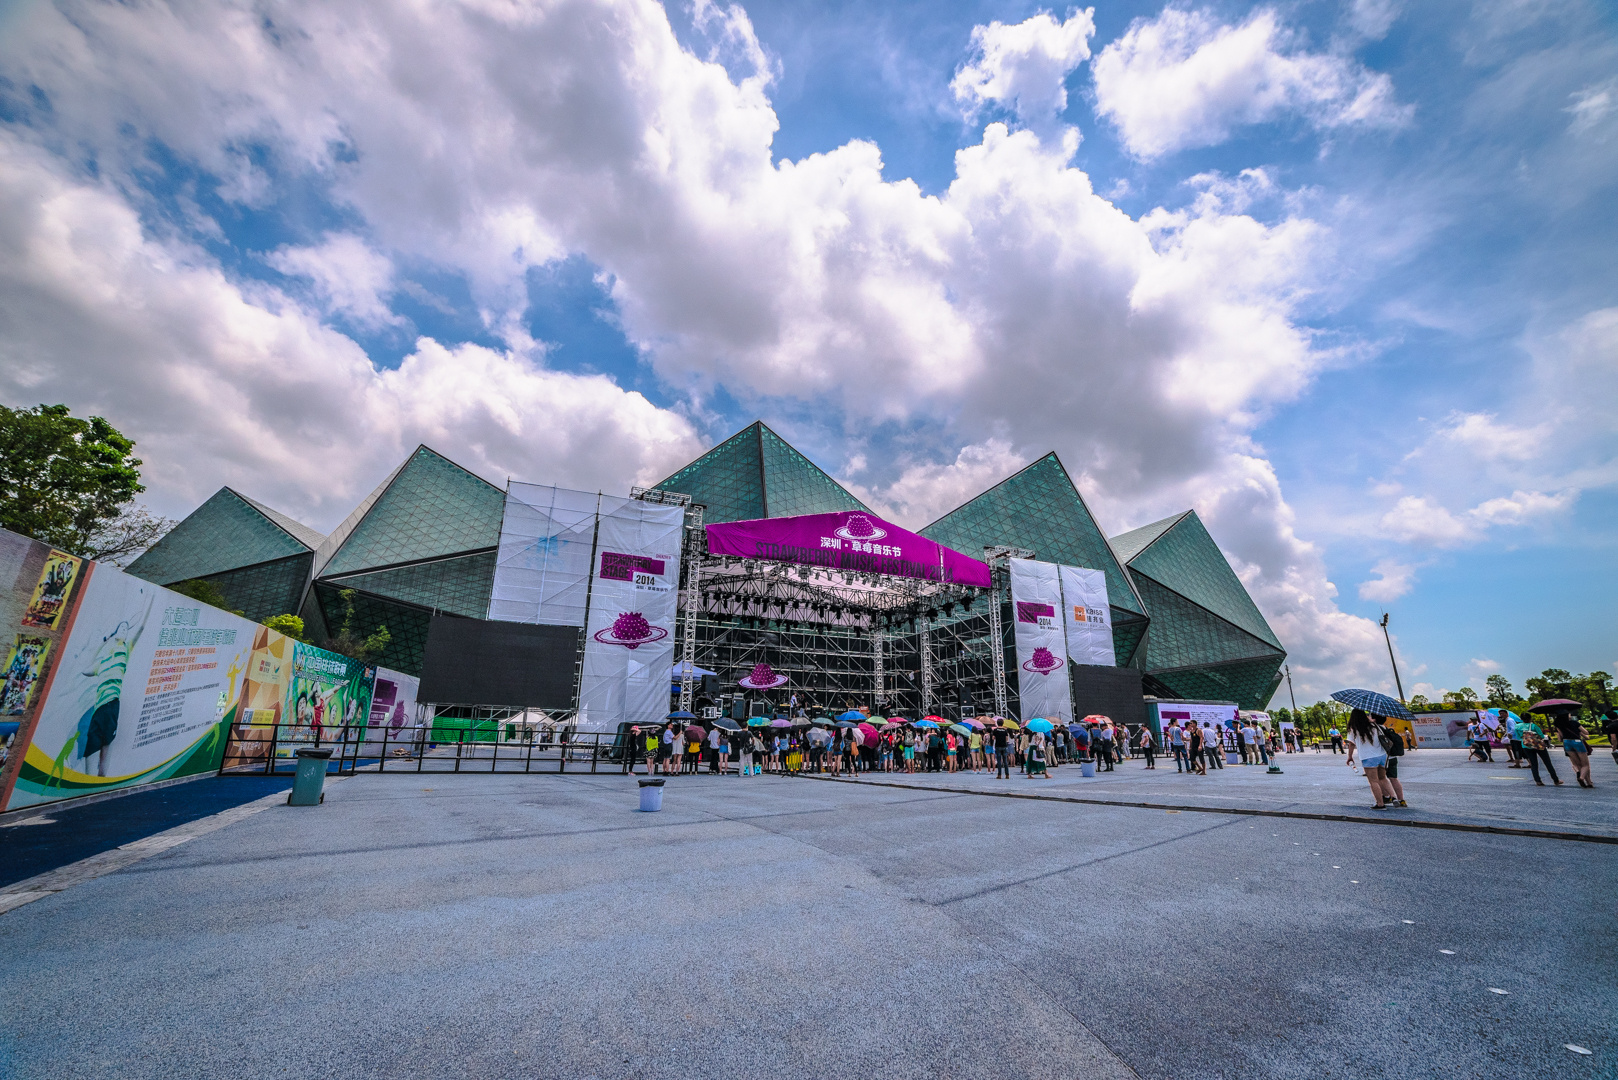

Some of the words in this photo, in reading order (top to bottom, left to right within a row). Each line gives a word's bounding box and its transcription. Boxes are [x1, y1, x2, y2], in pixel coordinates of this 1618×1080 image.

[755, 541, 837, 567] STRAWBERRY
[840, 552, 878, 571] MUSIC
[881, 558, 927, 578] FESTIVAL
[603, 565, 629, 578] STAGE
[636, 575, 655, 585] 2014
